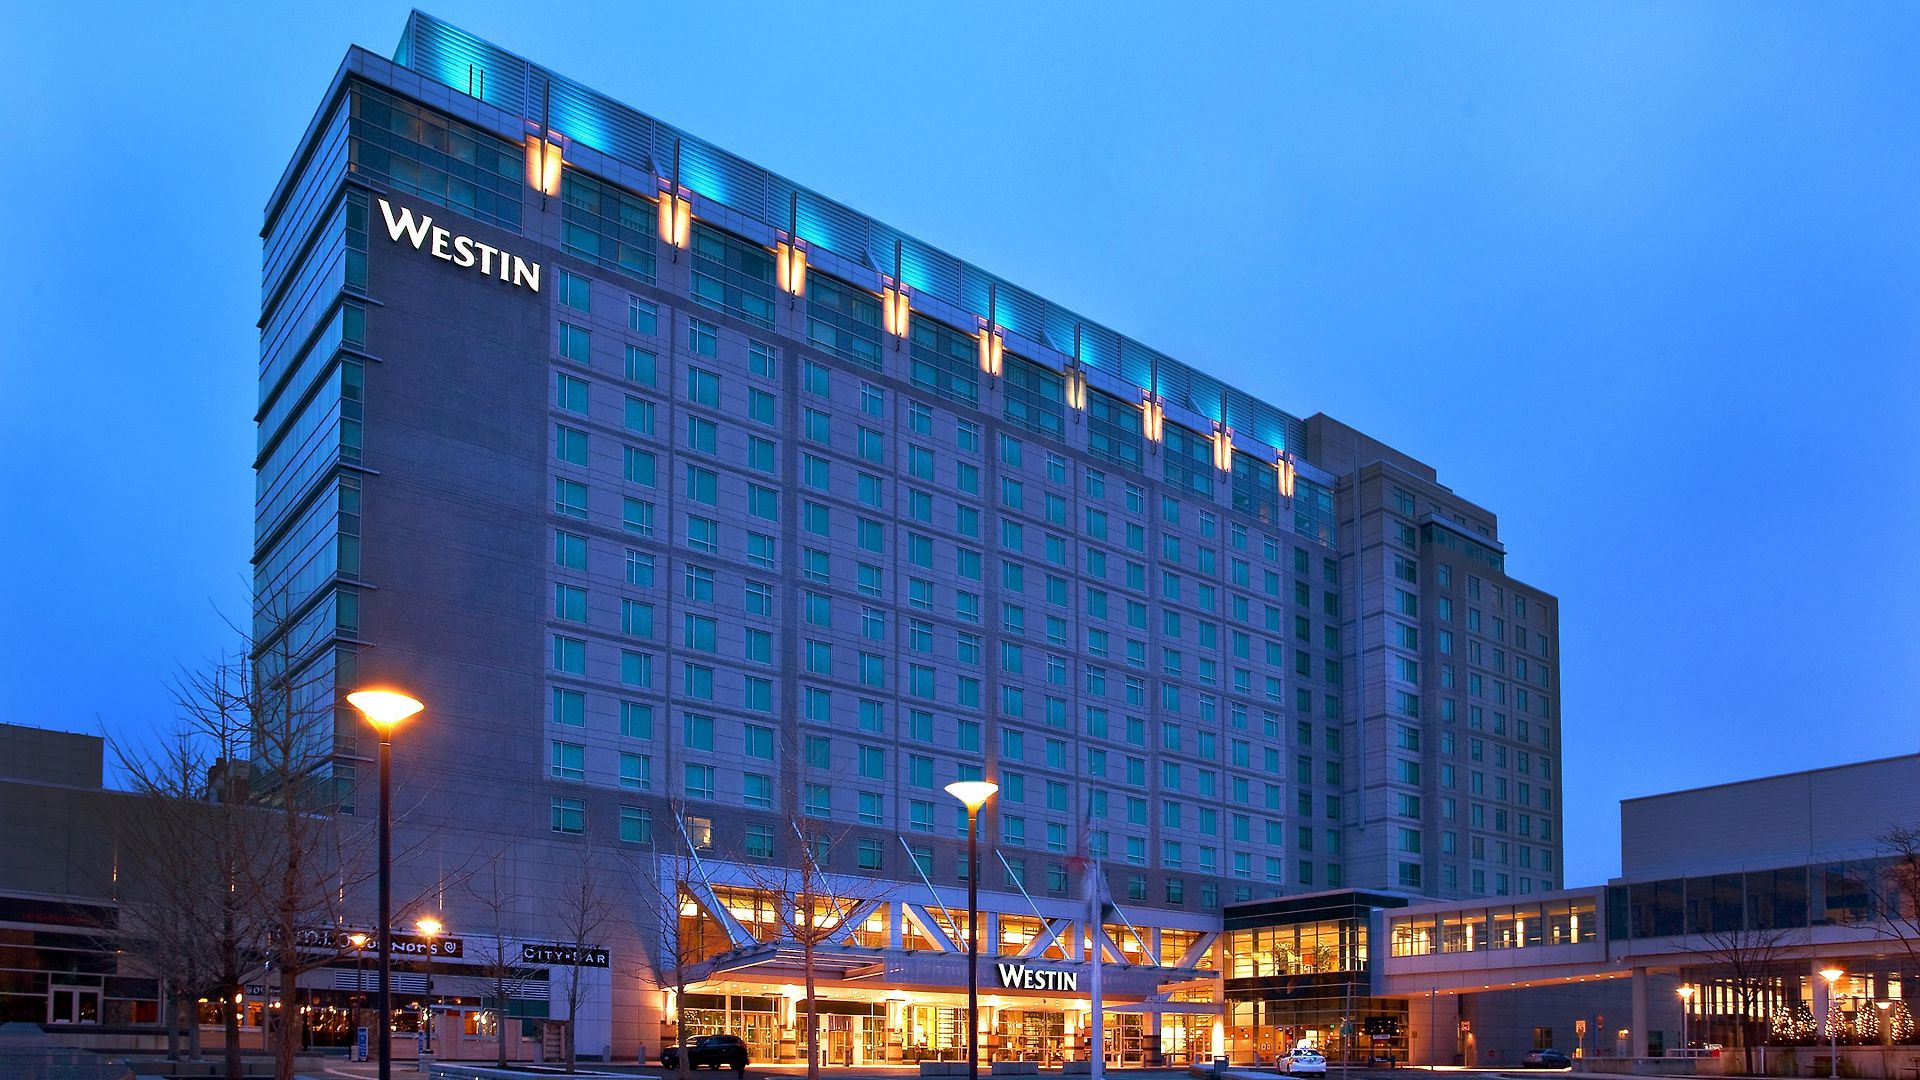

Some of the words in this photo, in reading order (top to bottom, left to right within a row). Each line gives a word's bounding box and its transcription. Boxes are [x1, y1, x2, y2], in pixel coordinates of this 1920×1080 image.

[378, 198, 540, 292] WESTIN
[524, 948, 563, 960] CITY
[998, 963, 1077, 991] WESTIN
